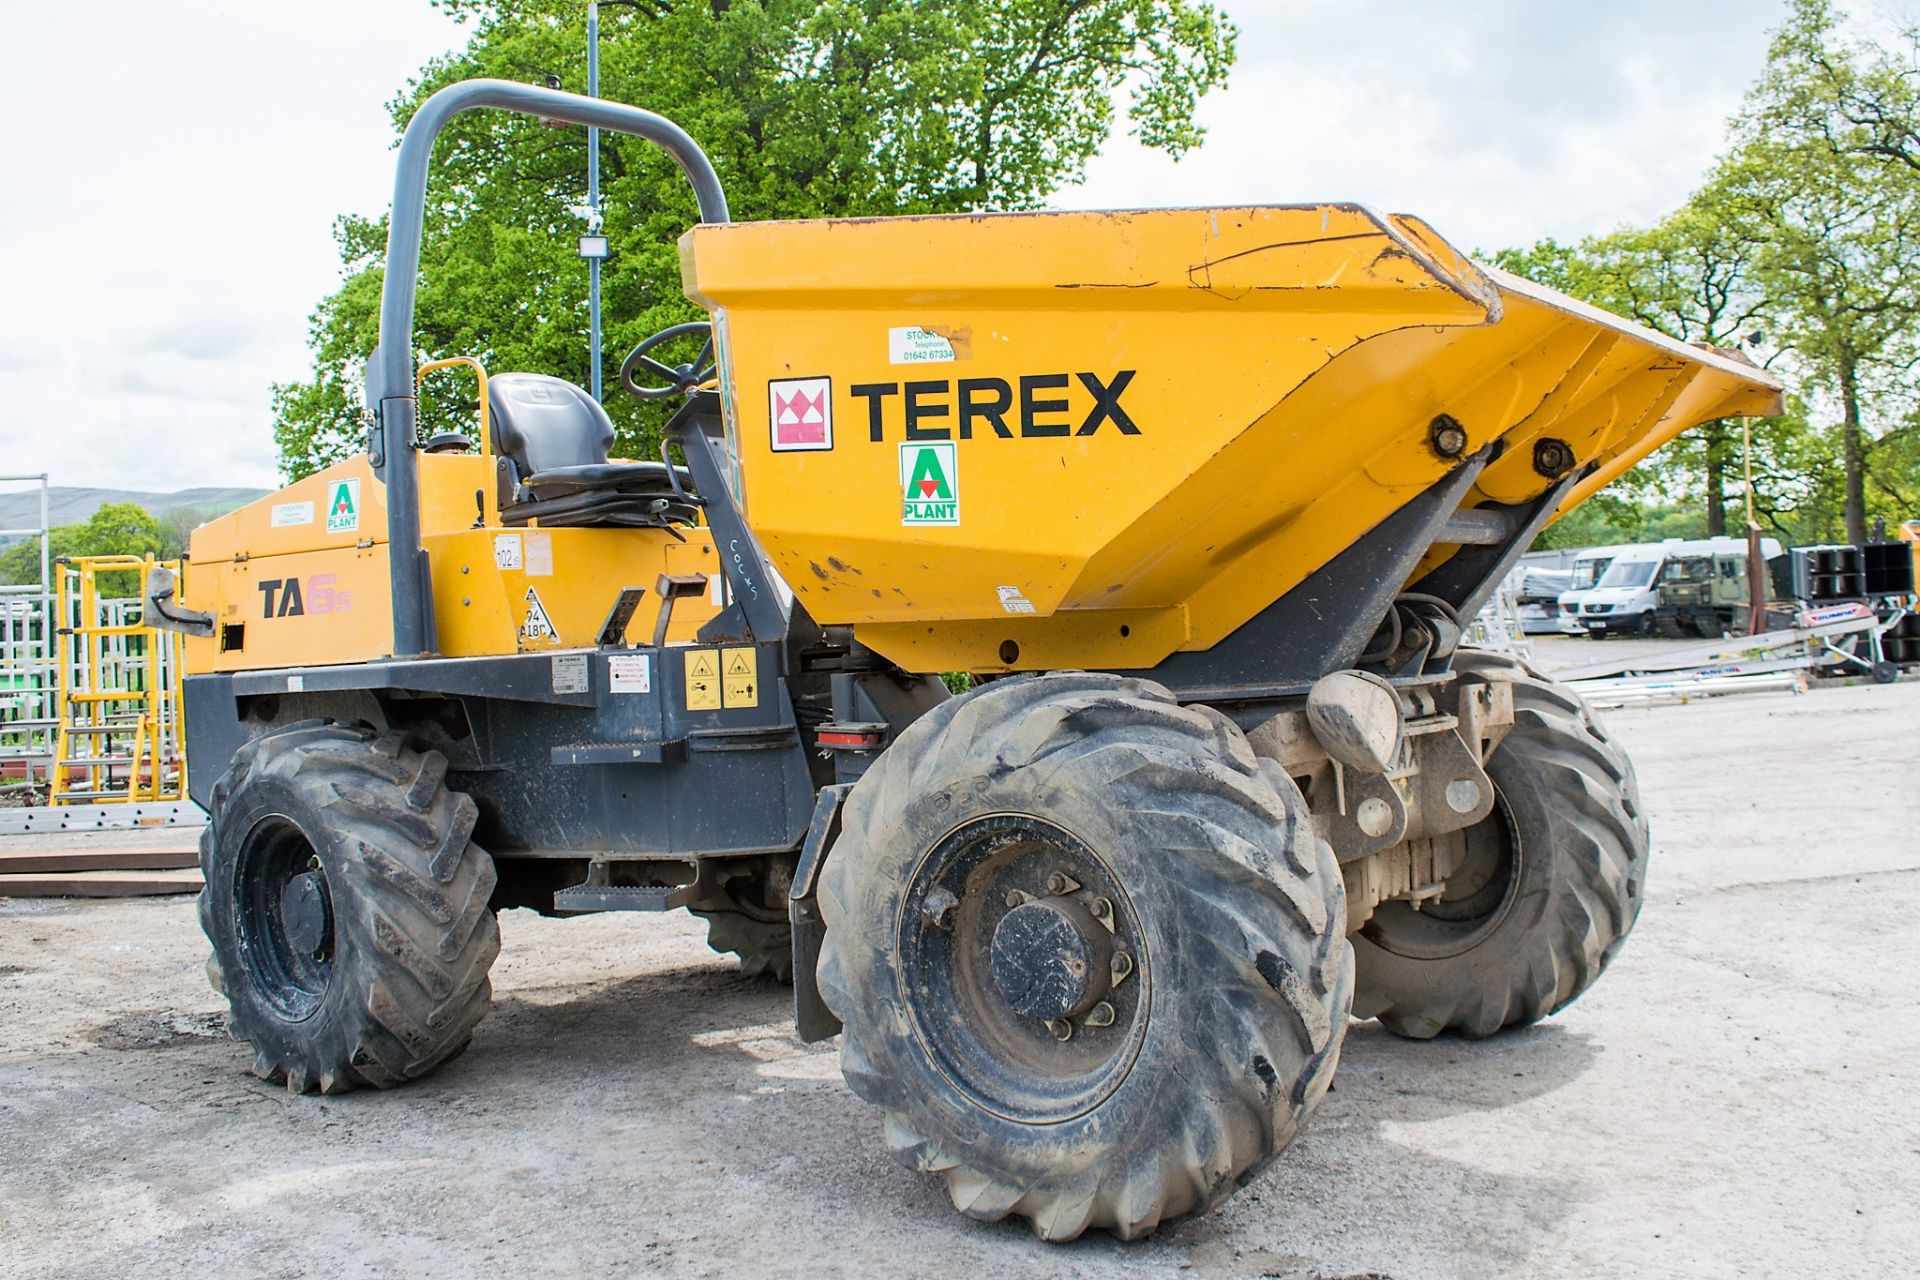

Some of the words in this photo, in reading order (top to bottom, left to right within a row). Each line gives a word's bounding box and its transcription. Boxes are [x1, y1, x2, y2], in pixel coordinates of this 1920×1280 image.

[904, 350, 927, 360] 01642
[850, 370, 1142, 442] TEREX
[906, 447, 953, 500] A
[904, 503, 957, 520] PLANT
[328, 516, 357, 529] PLANT
